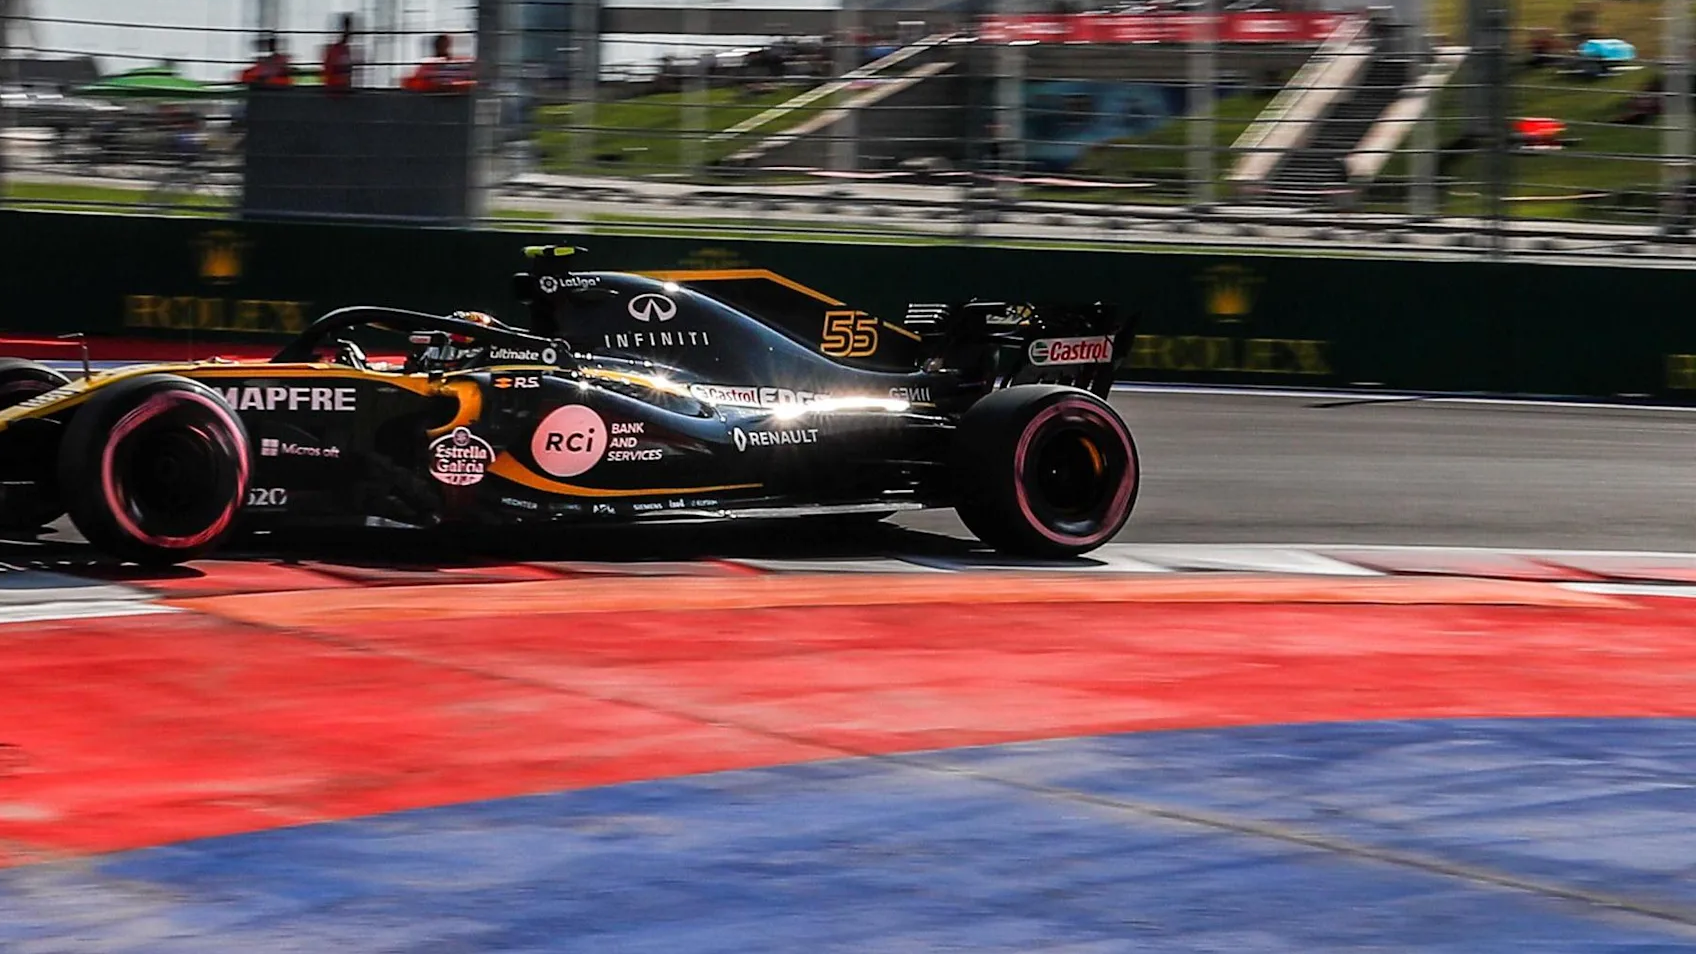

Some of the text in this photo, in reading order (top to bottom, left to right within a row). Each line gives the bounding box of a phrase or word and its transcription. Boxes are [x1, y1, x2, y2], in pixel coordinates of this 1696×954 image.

[605, 331, 710, 348] INFINITI
[821, 310, 878, 357] 55
[1050, 341, 1108, 361] Castrol
[710, 387, 755, 402] Castrol
[611, 423, 645, 434] BANK
[610, 437, 638, 449] AND
[750, 430, 819, 445] RENAULT
[435, 444, 487, 459] Estrella
[608, 450, 663, 461] SERVICES
[437, 459, 484, 473] Galicia
